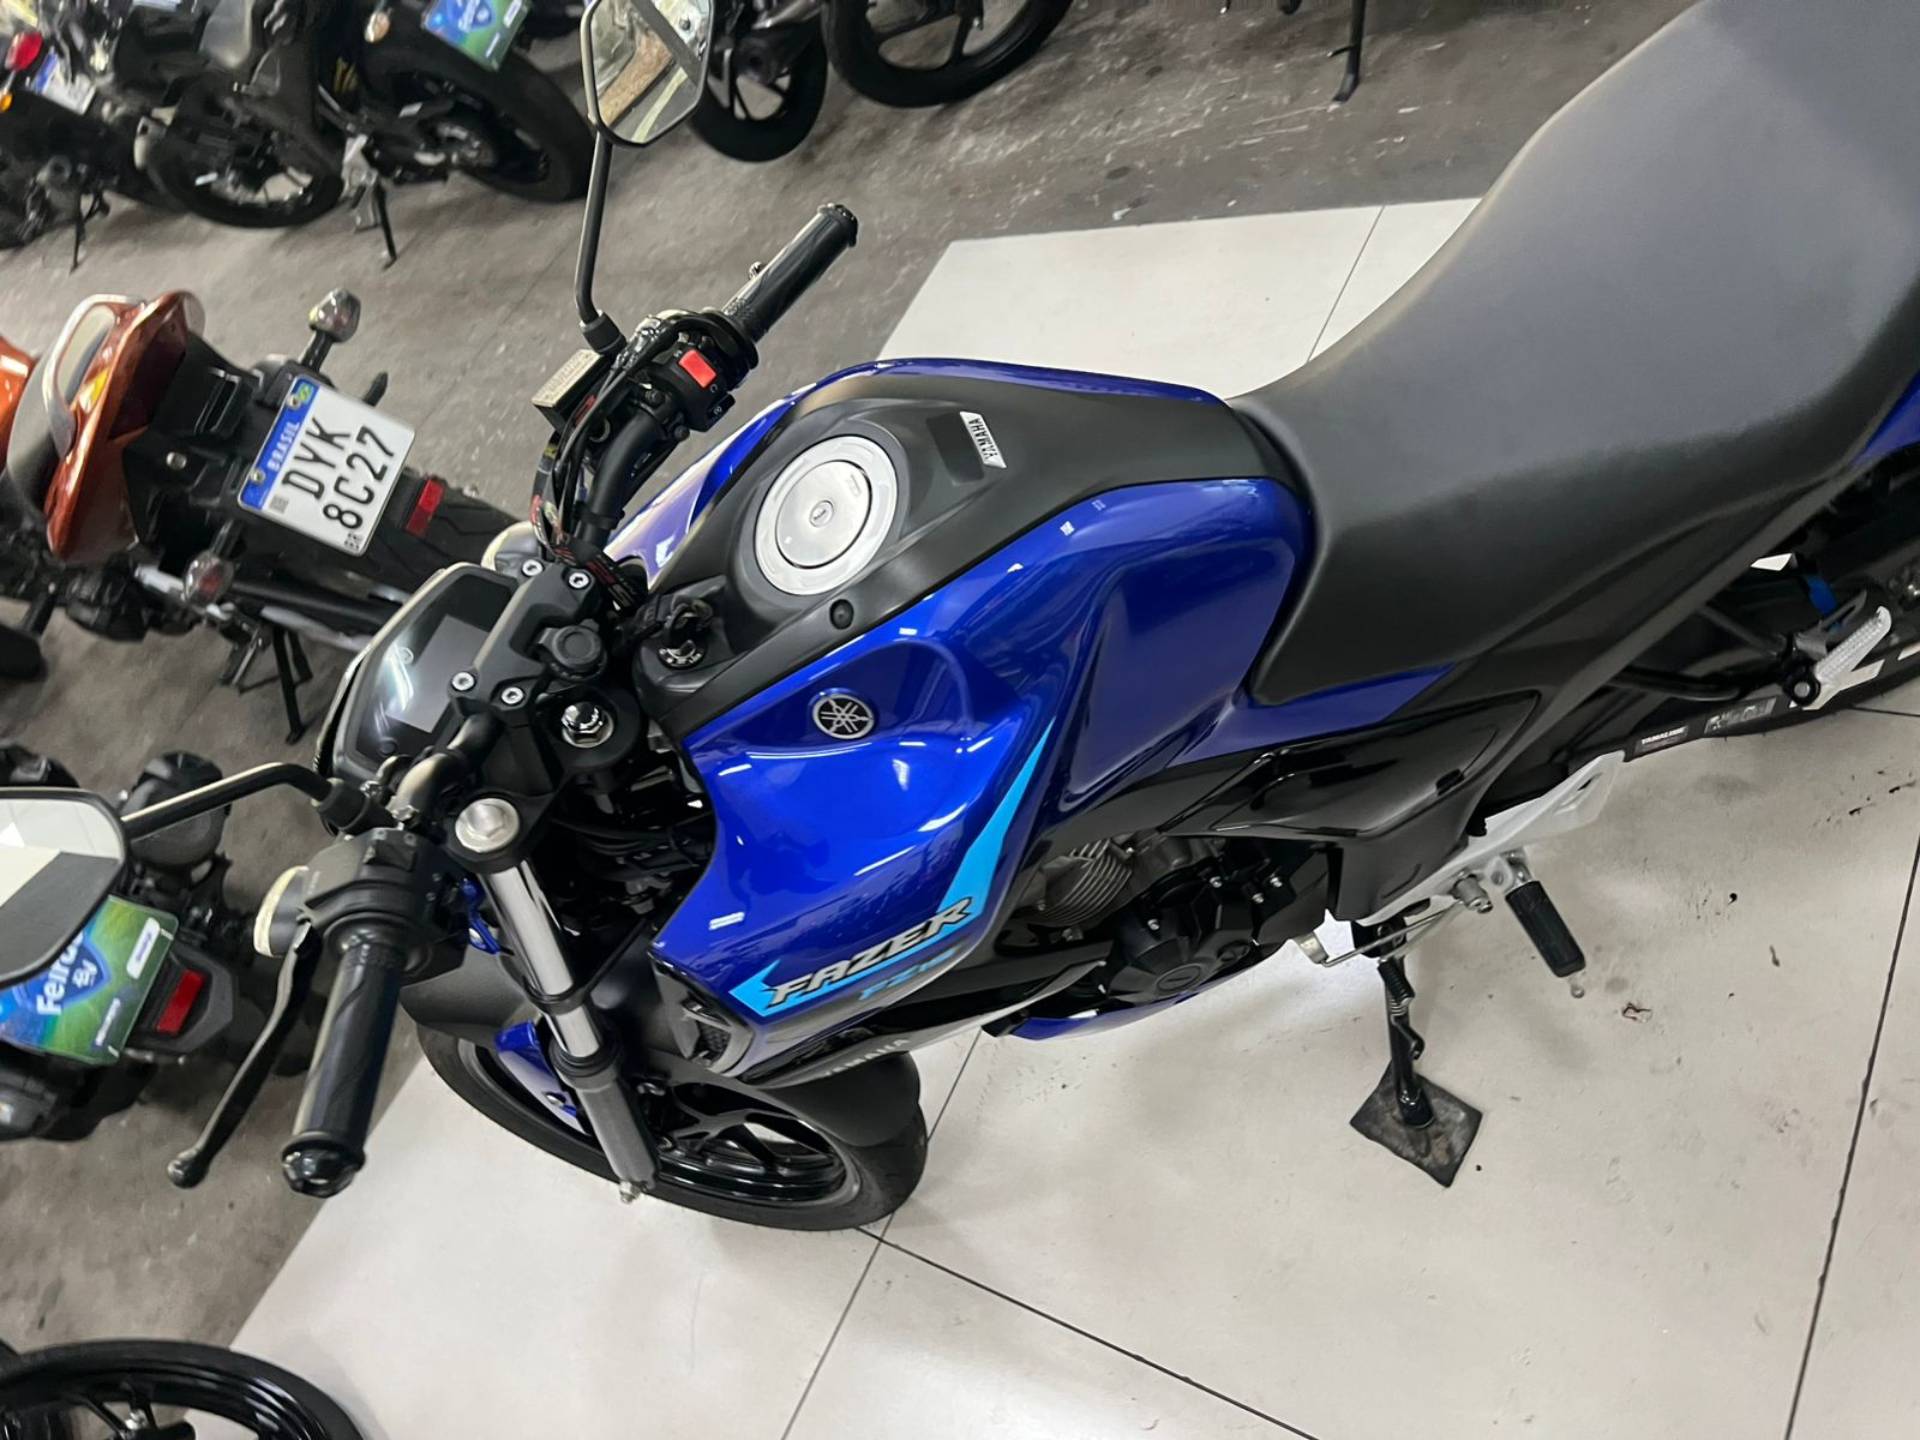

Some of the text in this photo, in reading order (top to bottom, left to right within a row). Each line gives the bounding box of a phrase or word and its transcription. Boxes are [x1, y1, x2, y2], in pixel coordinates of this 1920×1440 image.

[267, 421, 300, 472] BRASIL
[281, 416, 352, 501] DYK
[322, 425, 394, 529] 8C27
[967, 418, 998, 460] YAMAHA
[764, 896, 973, 1009] FAZER
